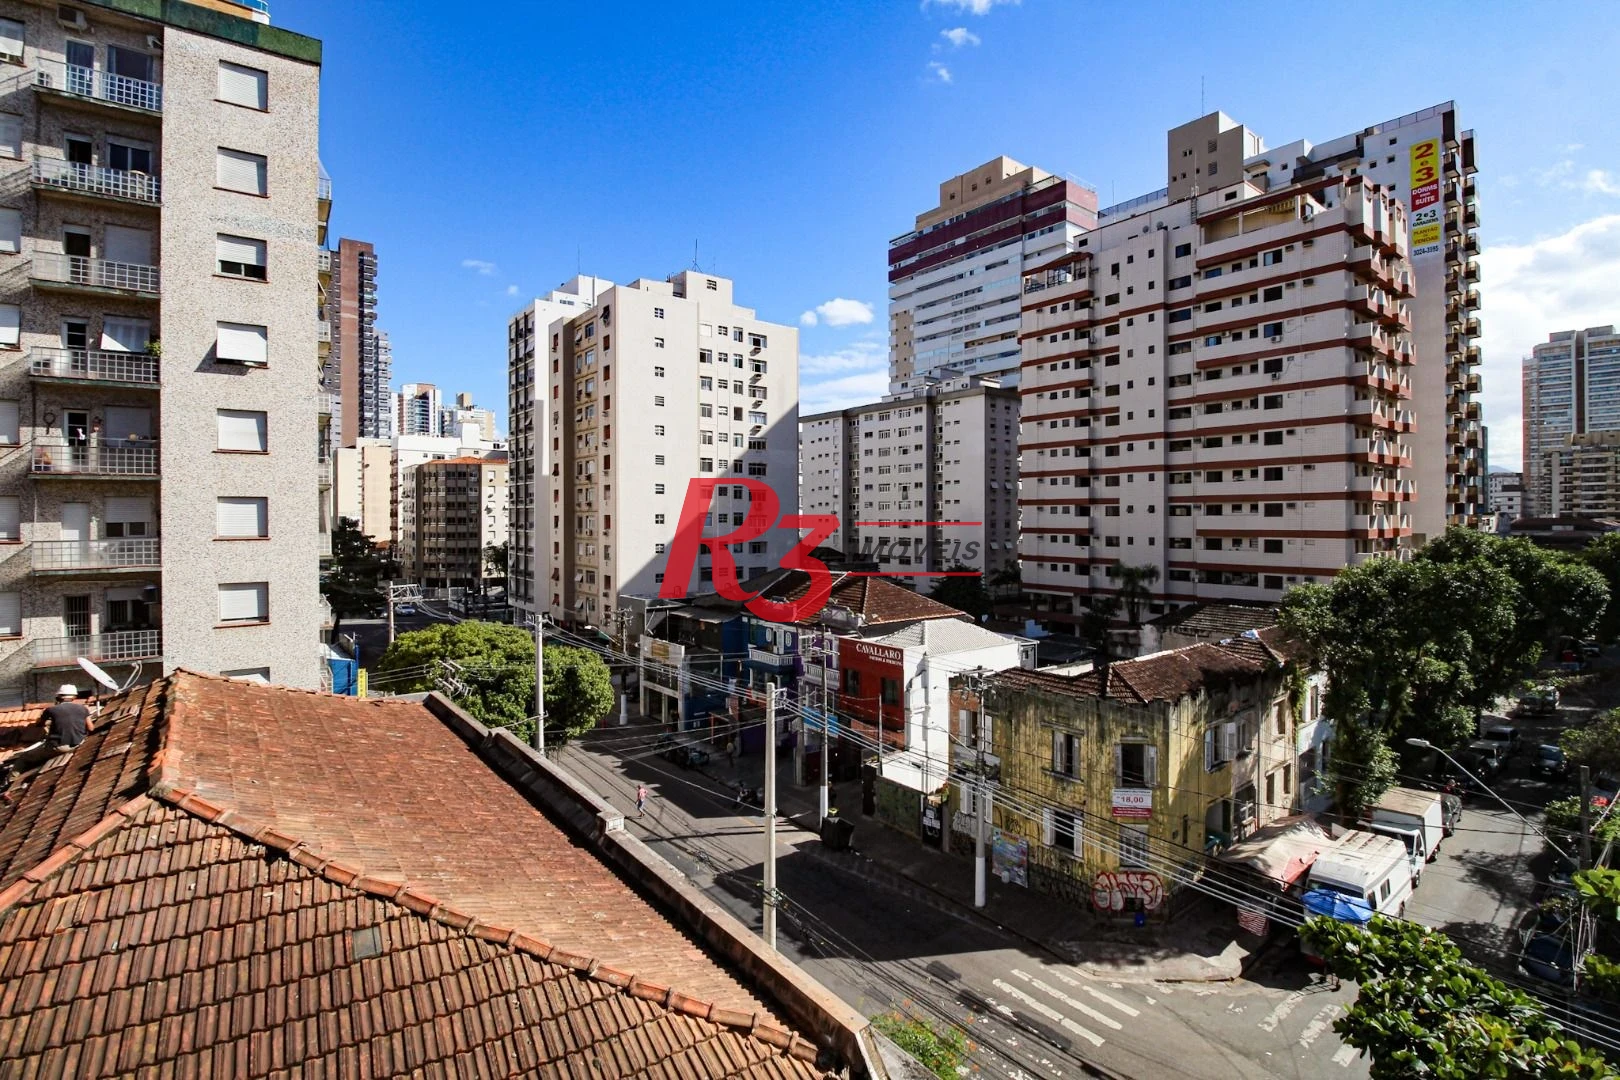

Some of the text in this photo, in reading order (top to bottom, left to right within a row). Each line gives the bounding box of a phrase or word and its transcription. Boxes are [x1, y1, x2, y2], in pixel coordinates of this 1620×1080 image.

[1415, 143, 1434, 160] 2
[1415, 166, 1434, 182] 3
[1412, 183, 1438, 195] DORMS
[1415, 213, 1423, 222] 2
[1429, 209, 1436, 218] 3
[855, 643, 901, 661] CAVALLARO
